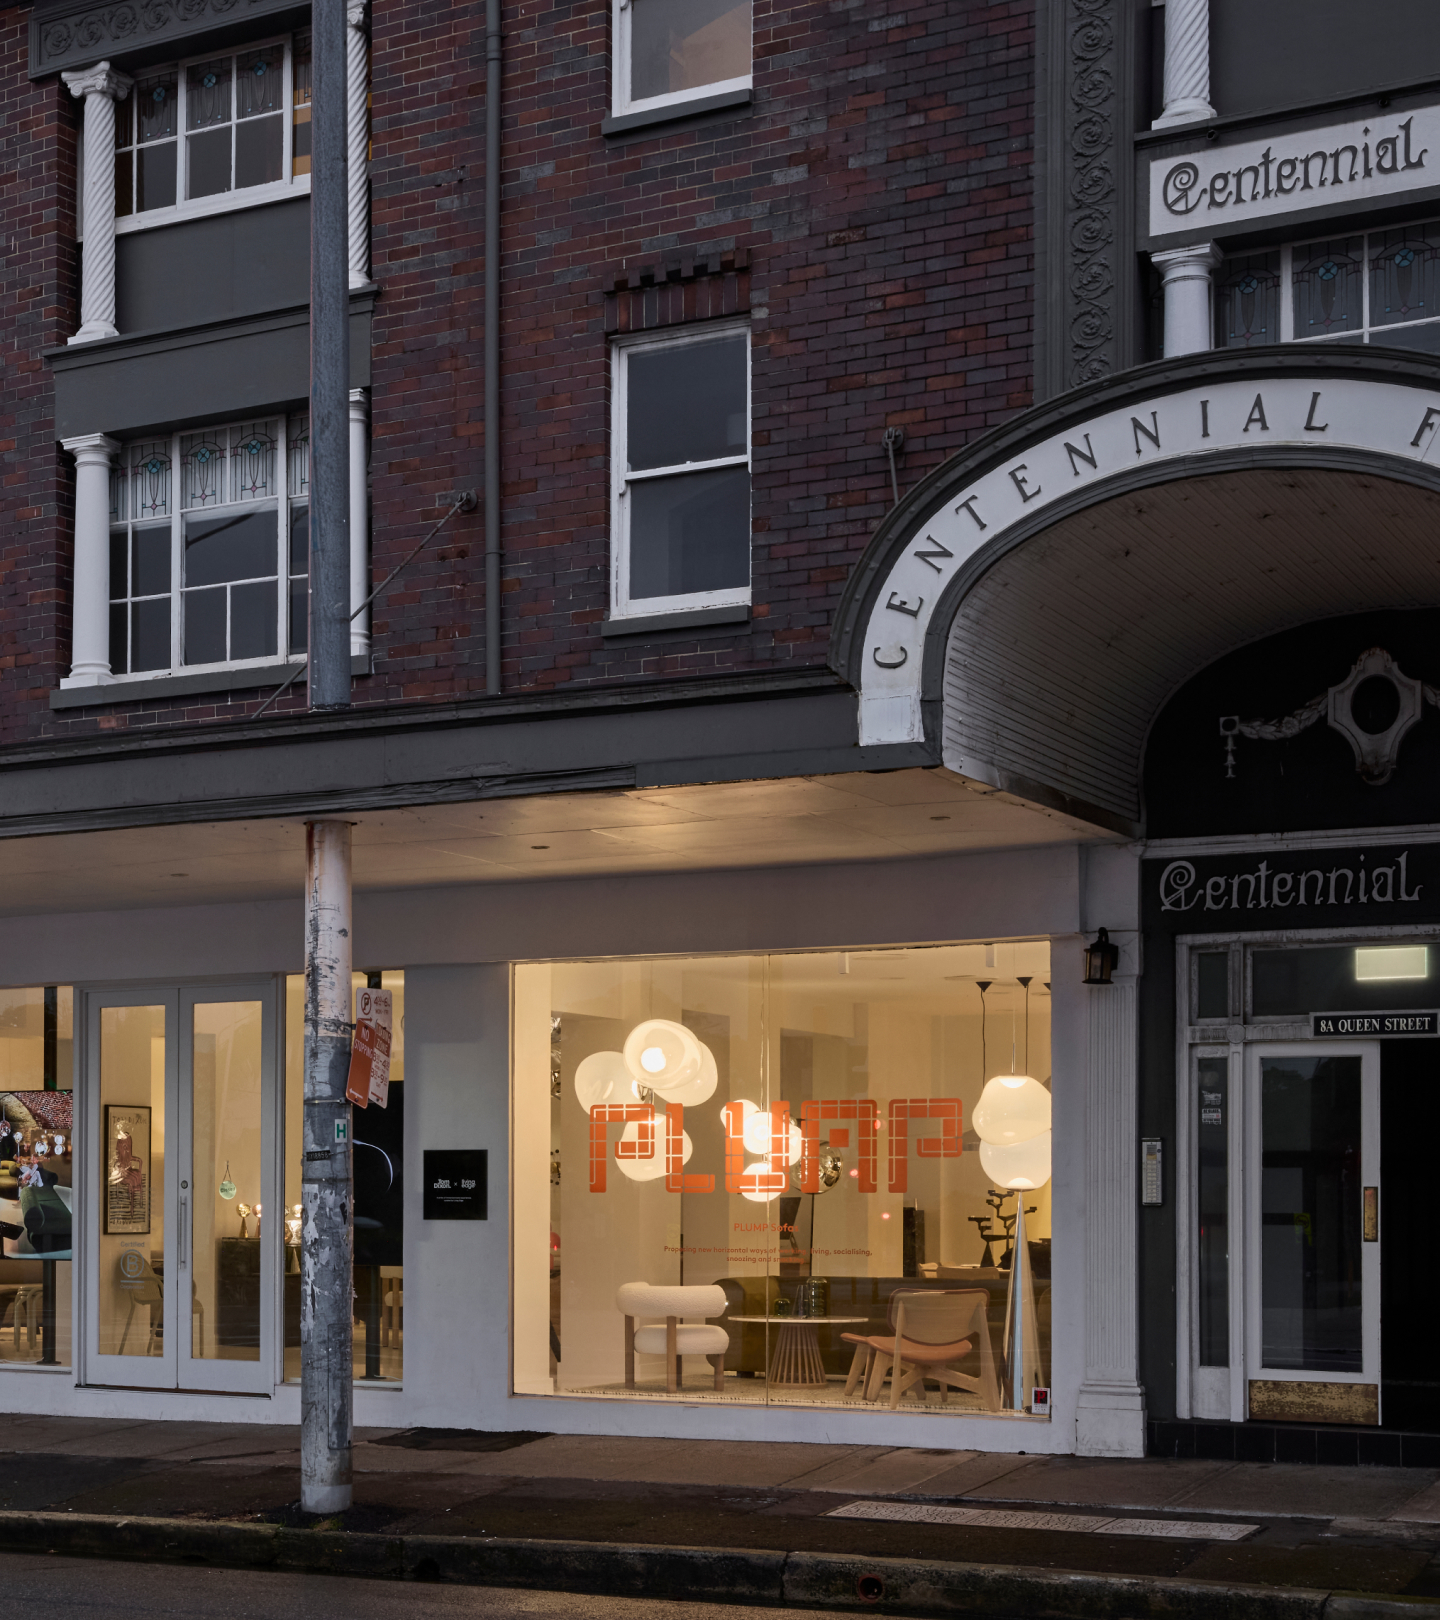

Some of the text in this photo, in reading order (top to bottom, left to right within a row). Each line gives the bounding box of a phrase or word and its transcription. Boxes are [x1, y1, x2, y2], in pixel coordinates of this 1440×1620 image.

[1163, 116, 1428, 215] Centennial
[873, 391, 1328, 669] CENTENNIAL
[1160, 851, 1424, 912] Centennial
[1320, 1017, 1431, 1033] 8A QUEEN STREET
[361, 1026, 370, 1042] NO
[354, 1038, 373, 1059] STOPPING
[337, 1124, 346, 1138] H
[589, 1097, 963, 1194] PLUMP
[733, 1222, 799, 1232] PLUMP Sofas
[664, 1246, 697, 1254] Proposing
[833, 1247, 873, 1257] socialising,
[726, 1256, 757, 1264] snoozing
